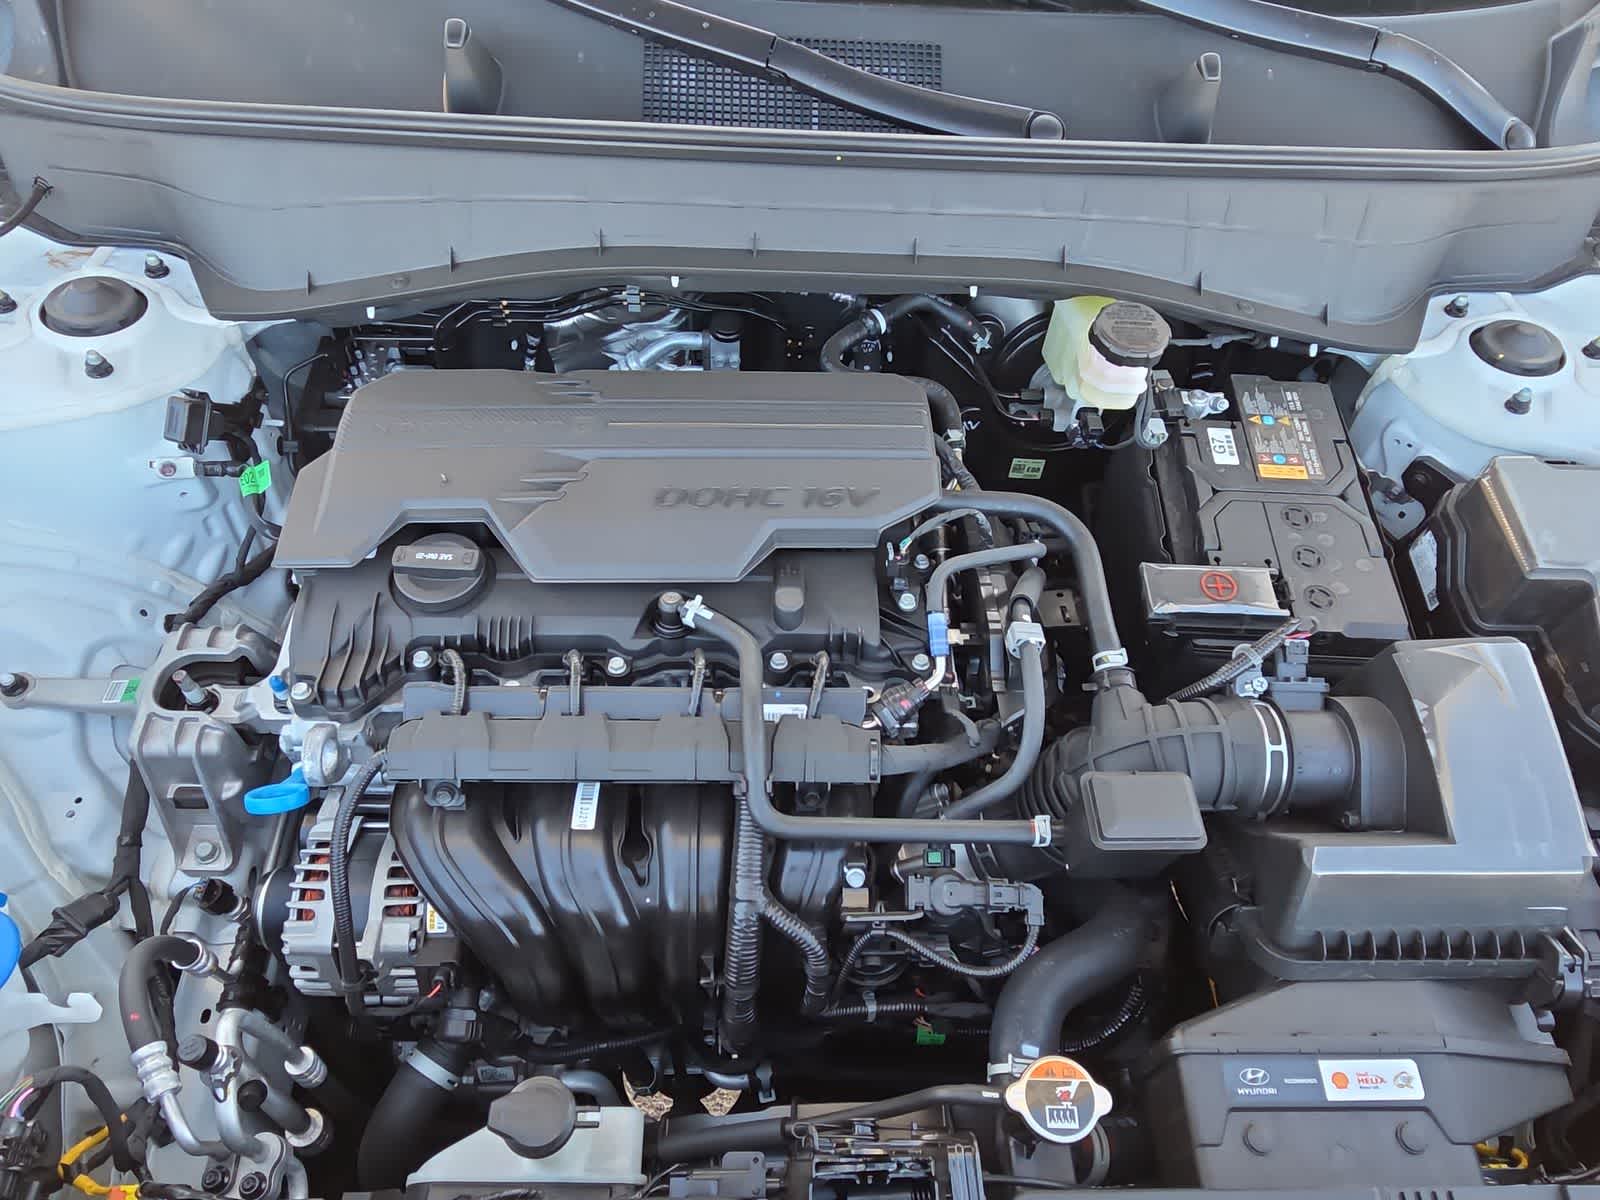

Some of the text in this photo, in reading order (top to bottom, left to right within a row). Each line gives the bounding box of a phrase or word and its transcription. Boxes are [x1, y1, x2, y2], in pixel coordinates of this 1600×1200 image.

[1211, 437, 1226, 454] G7
[655, 487, 881, 508] DOHC 16V
[1237, 1087, 1278, 1096] HYUNDAI
